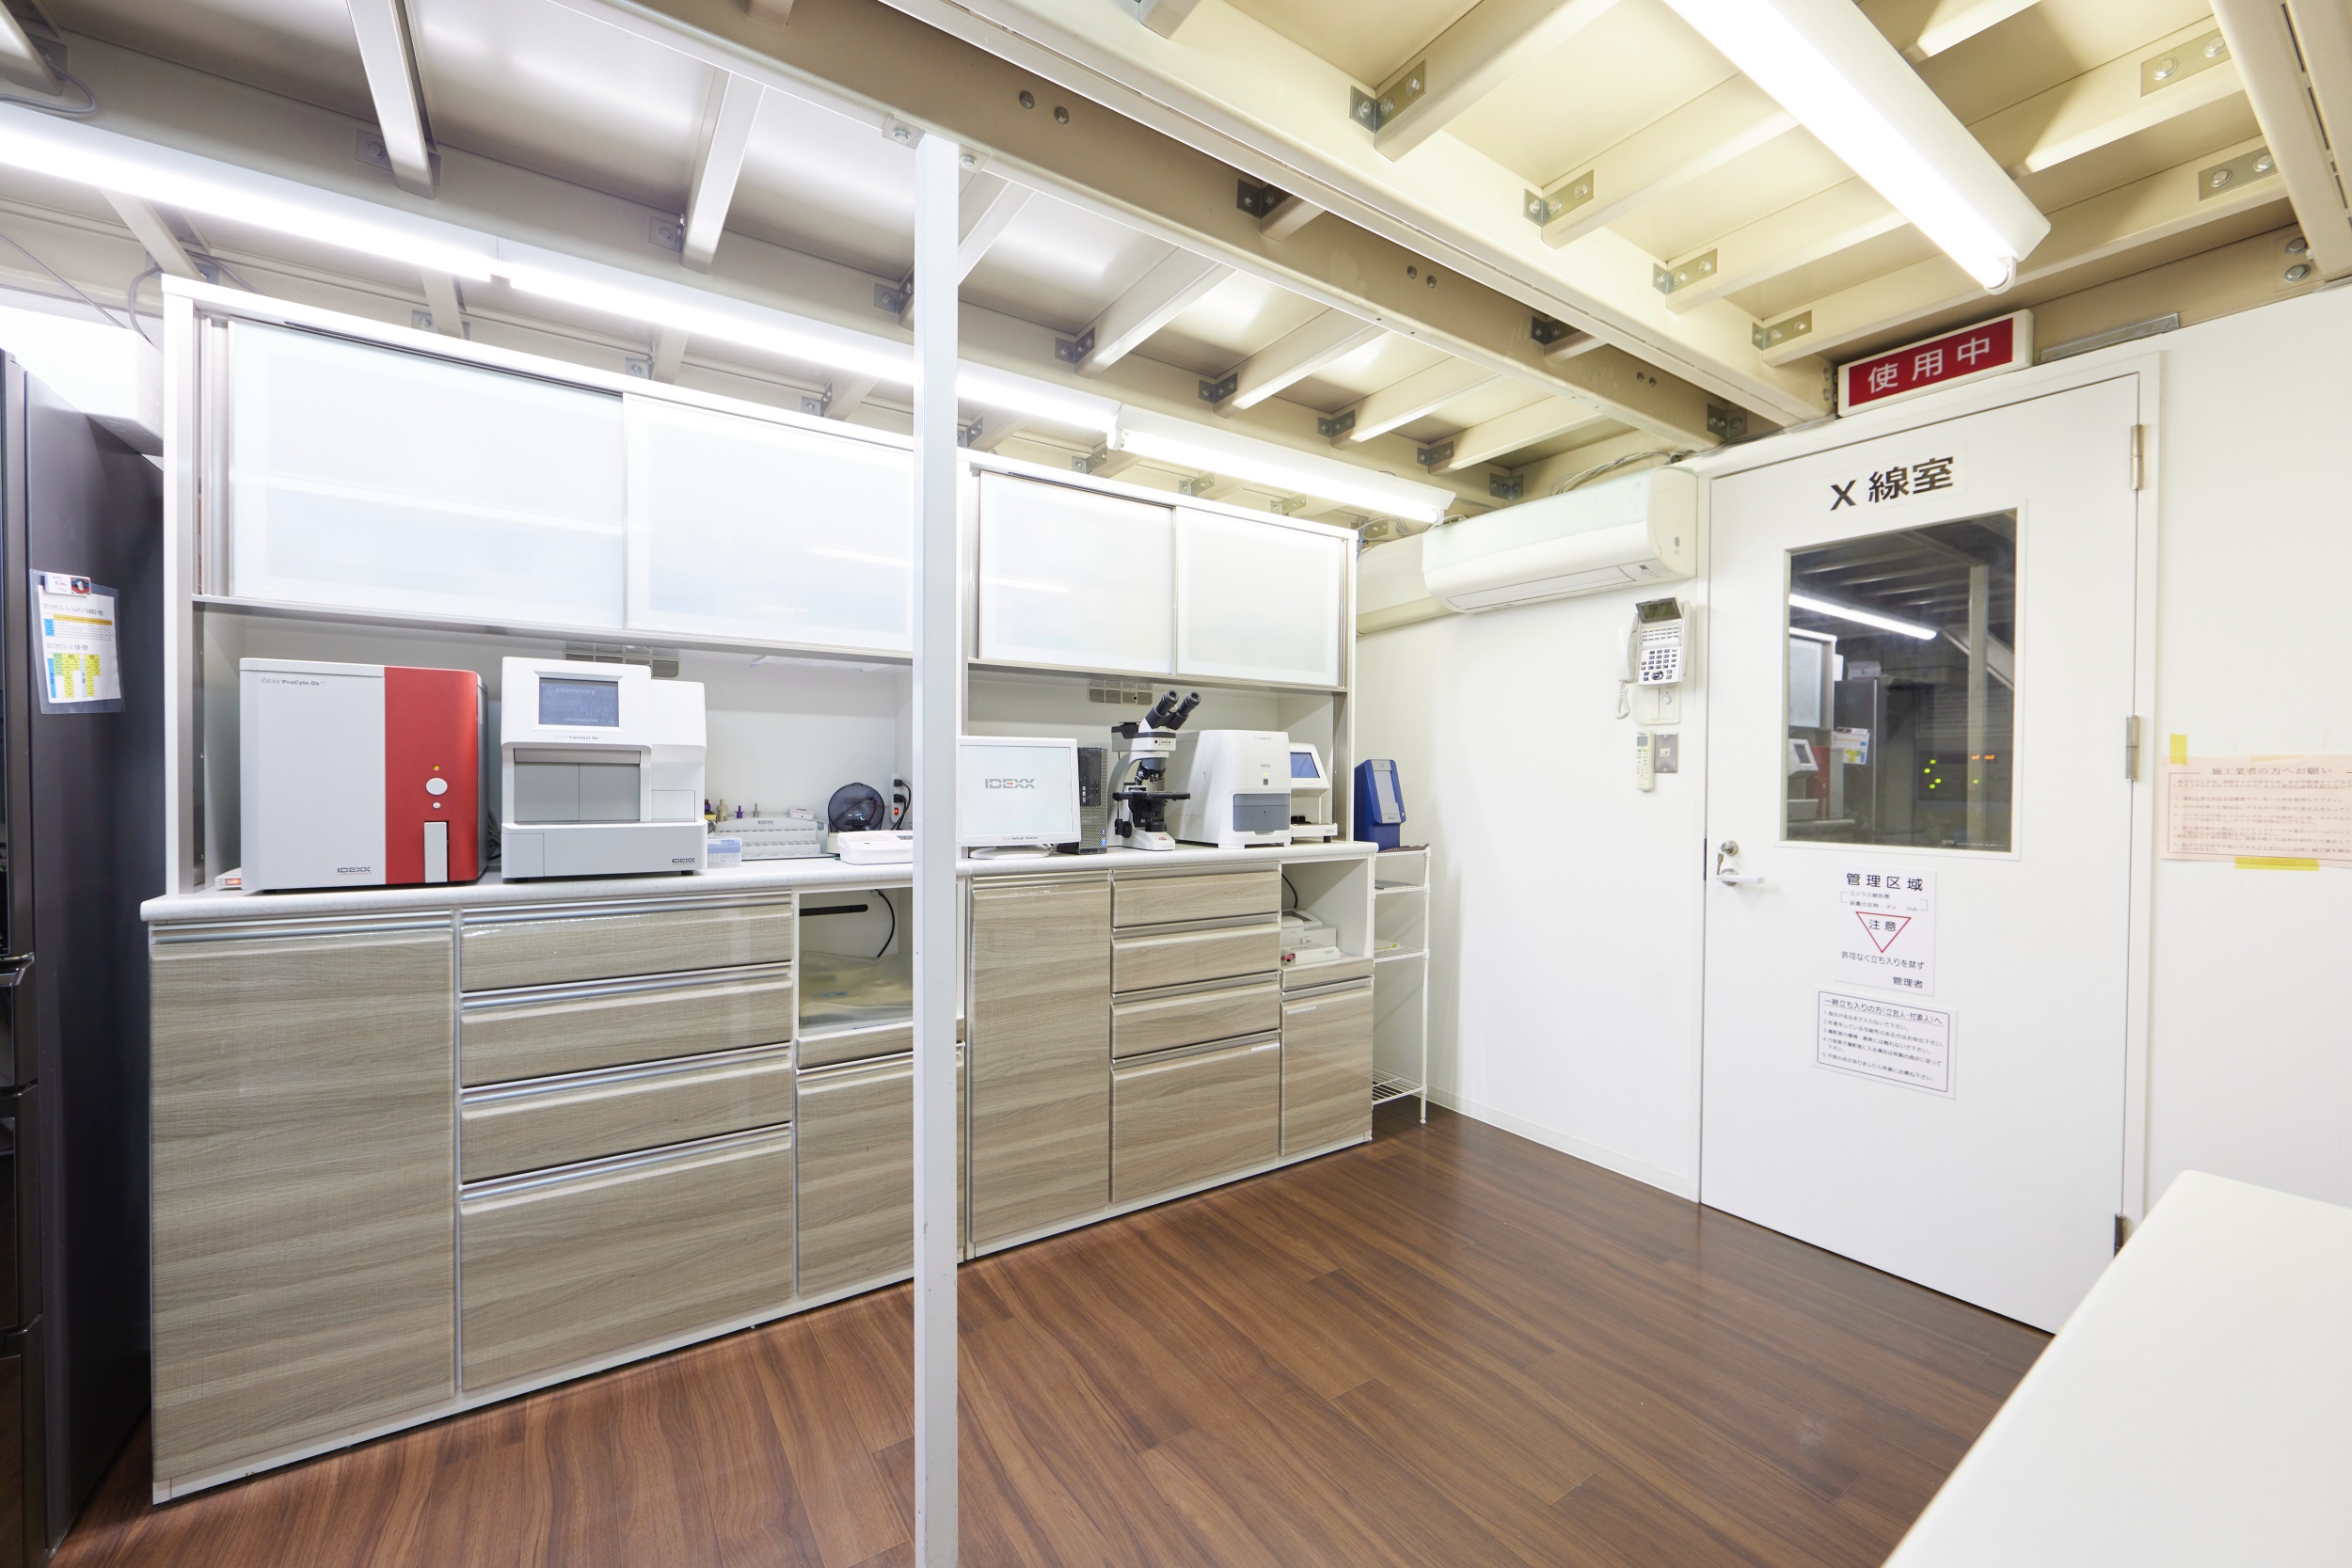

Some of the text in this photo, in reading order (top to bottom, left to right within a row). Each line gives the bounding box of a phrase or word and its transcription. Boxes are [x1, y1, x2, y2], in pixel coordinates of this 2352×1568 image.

[1867, 337, 1991, 394] 使用中
[2212, 767, 2333, 775] 施工業者の方へお願い
[985, 779, 1036, 788] IDEXX
[1846, 872, 1923, 891] 管理区域
[1850, 891, 1890, 899] エックス線診療
[1868, 919, 1897, 931] 注意
[1841, 951, 1925, 970] 許可なく立ち入りを禁ず
[1893, 976, 1924, 989] 管理者
